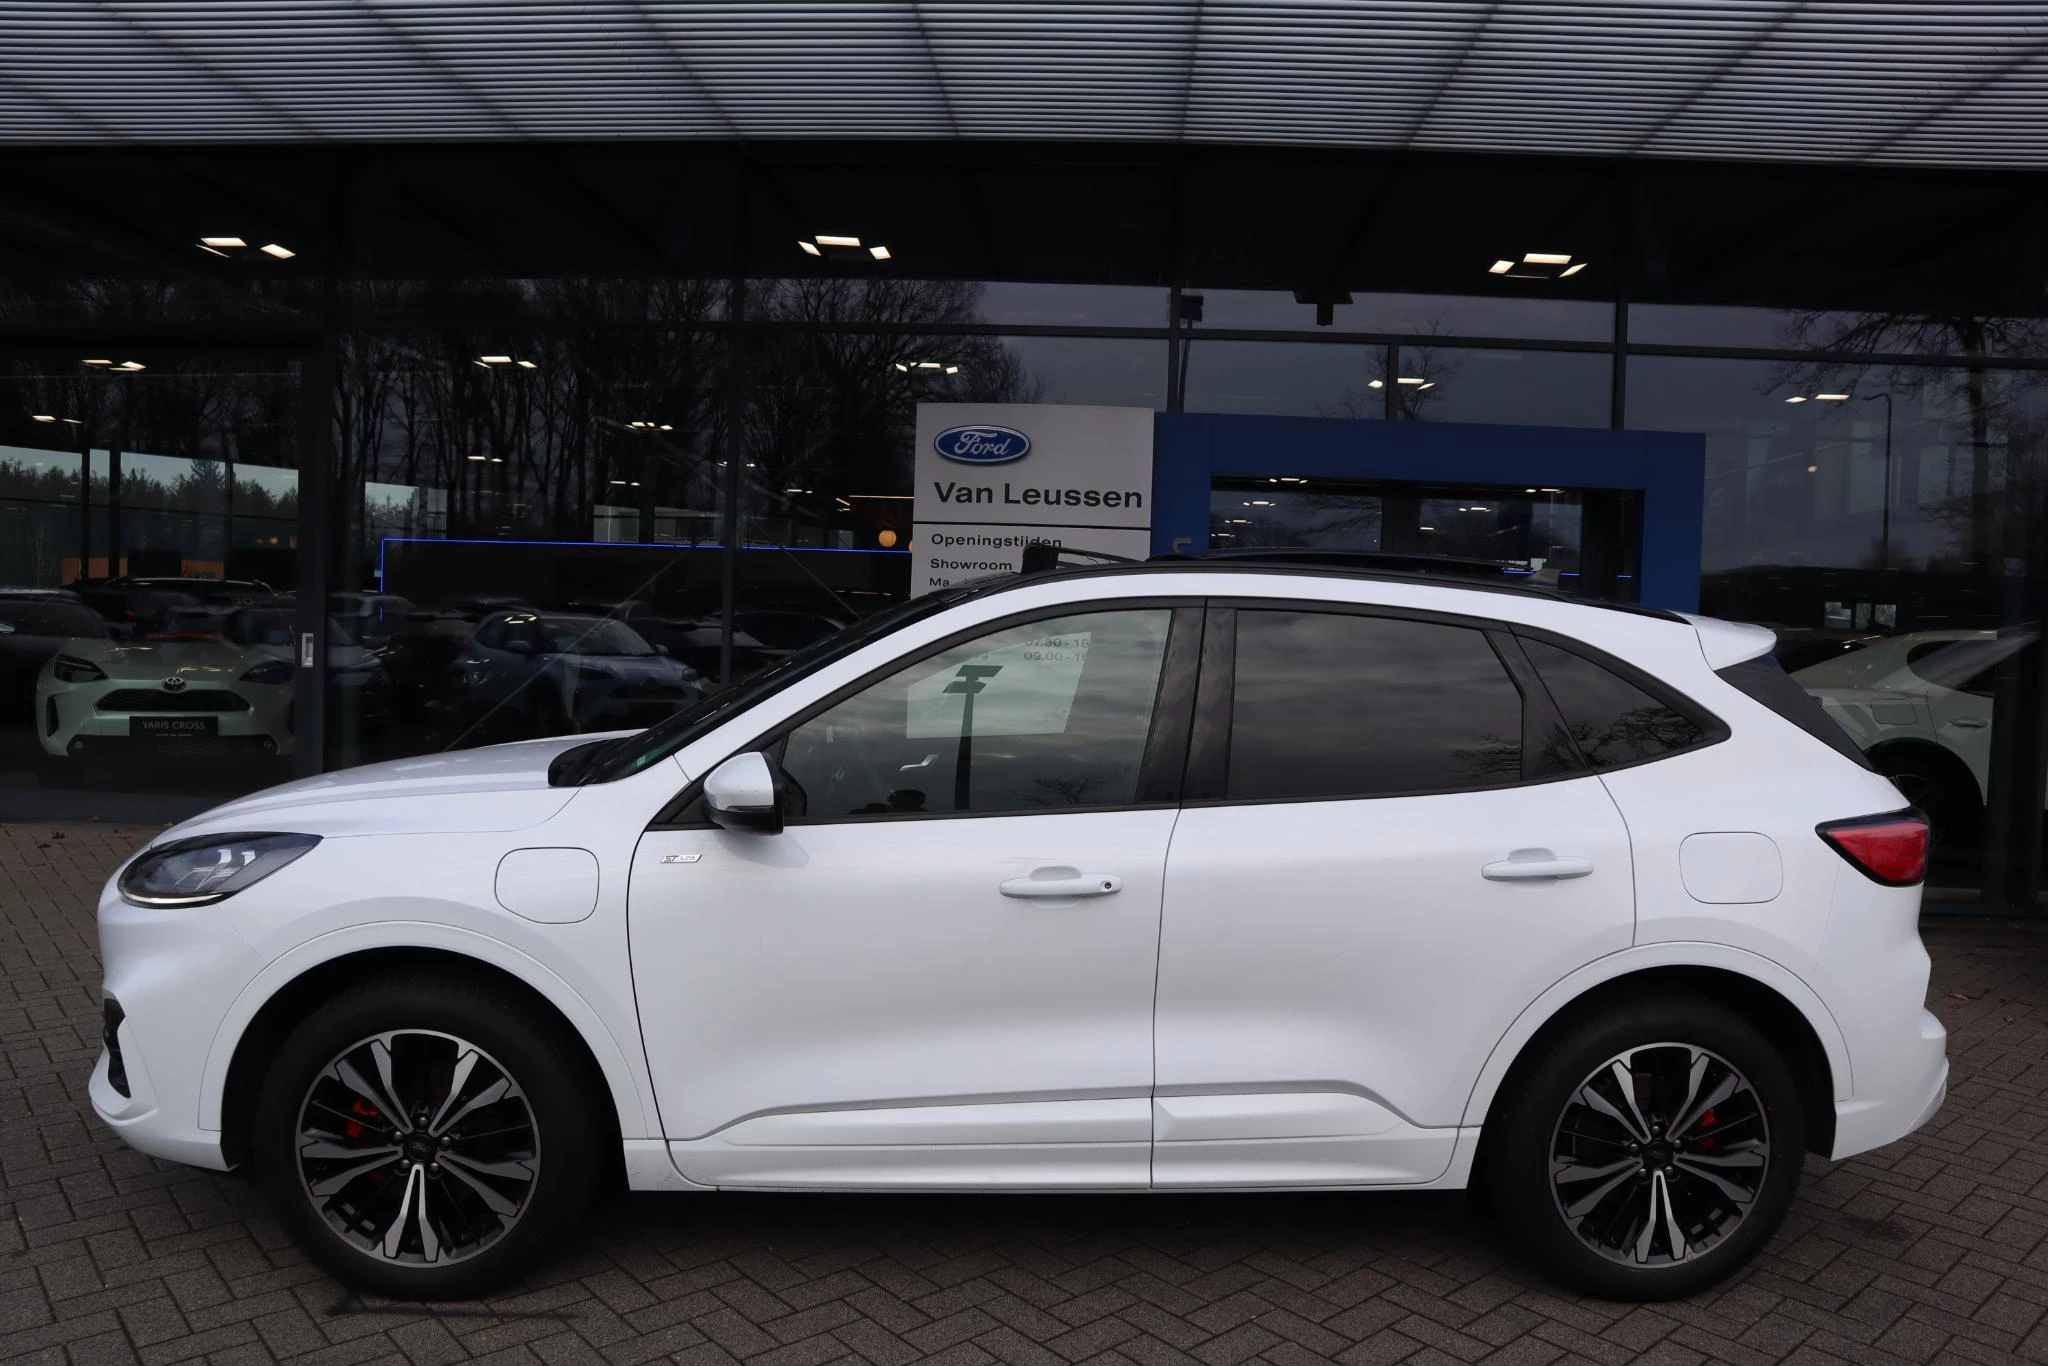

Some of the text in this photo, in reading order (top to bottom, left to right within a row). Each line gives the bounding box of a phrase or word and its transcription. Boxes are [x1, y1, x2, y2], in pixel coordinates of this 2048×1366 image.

[934, 482, 1143, 508] Van Leussen
[930, 558, 1012, 571] Showroom
[142, 720, 206, 730] YARIS CROSS
